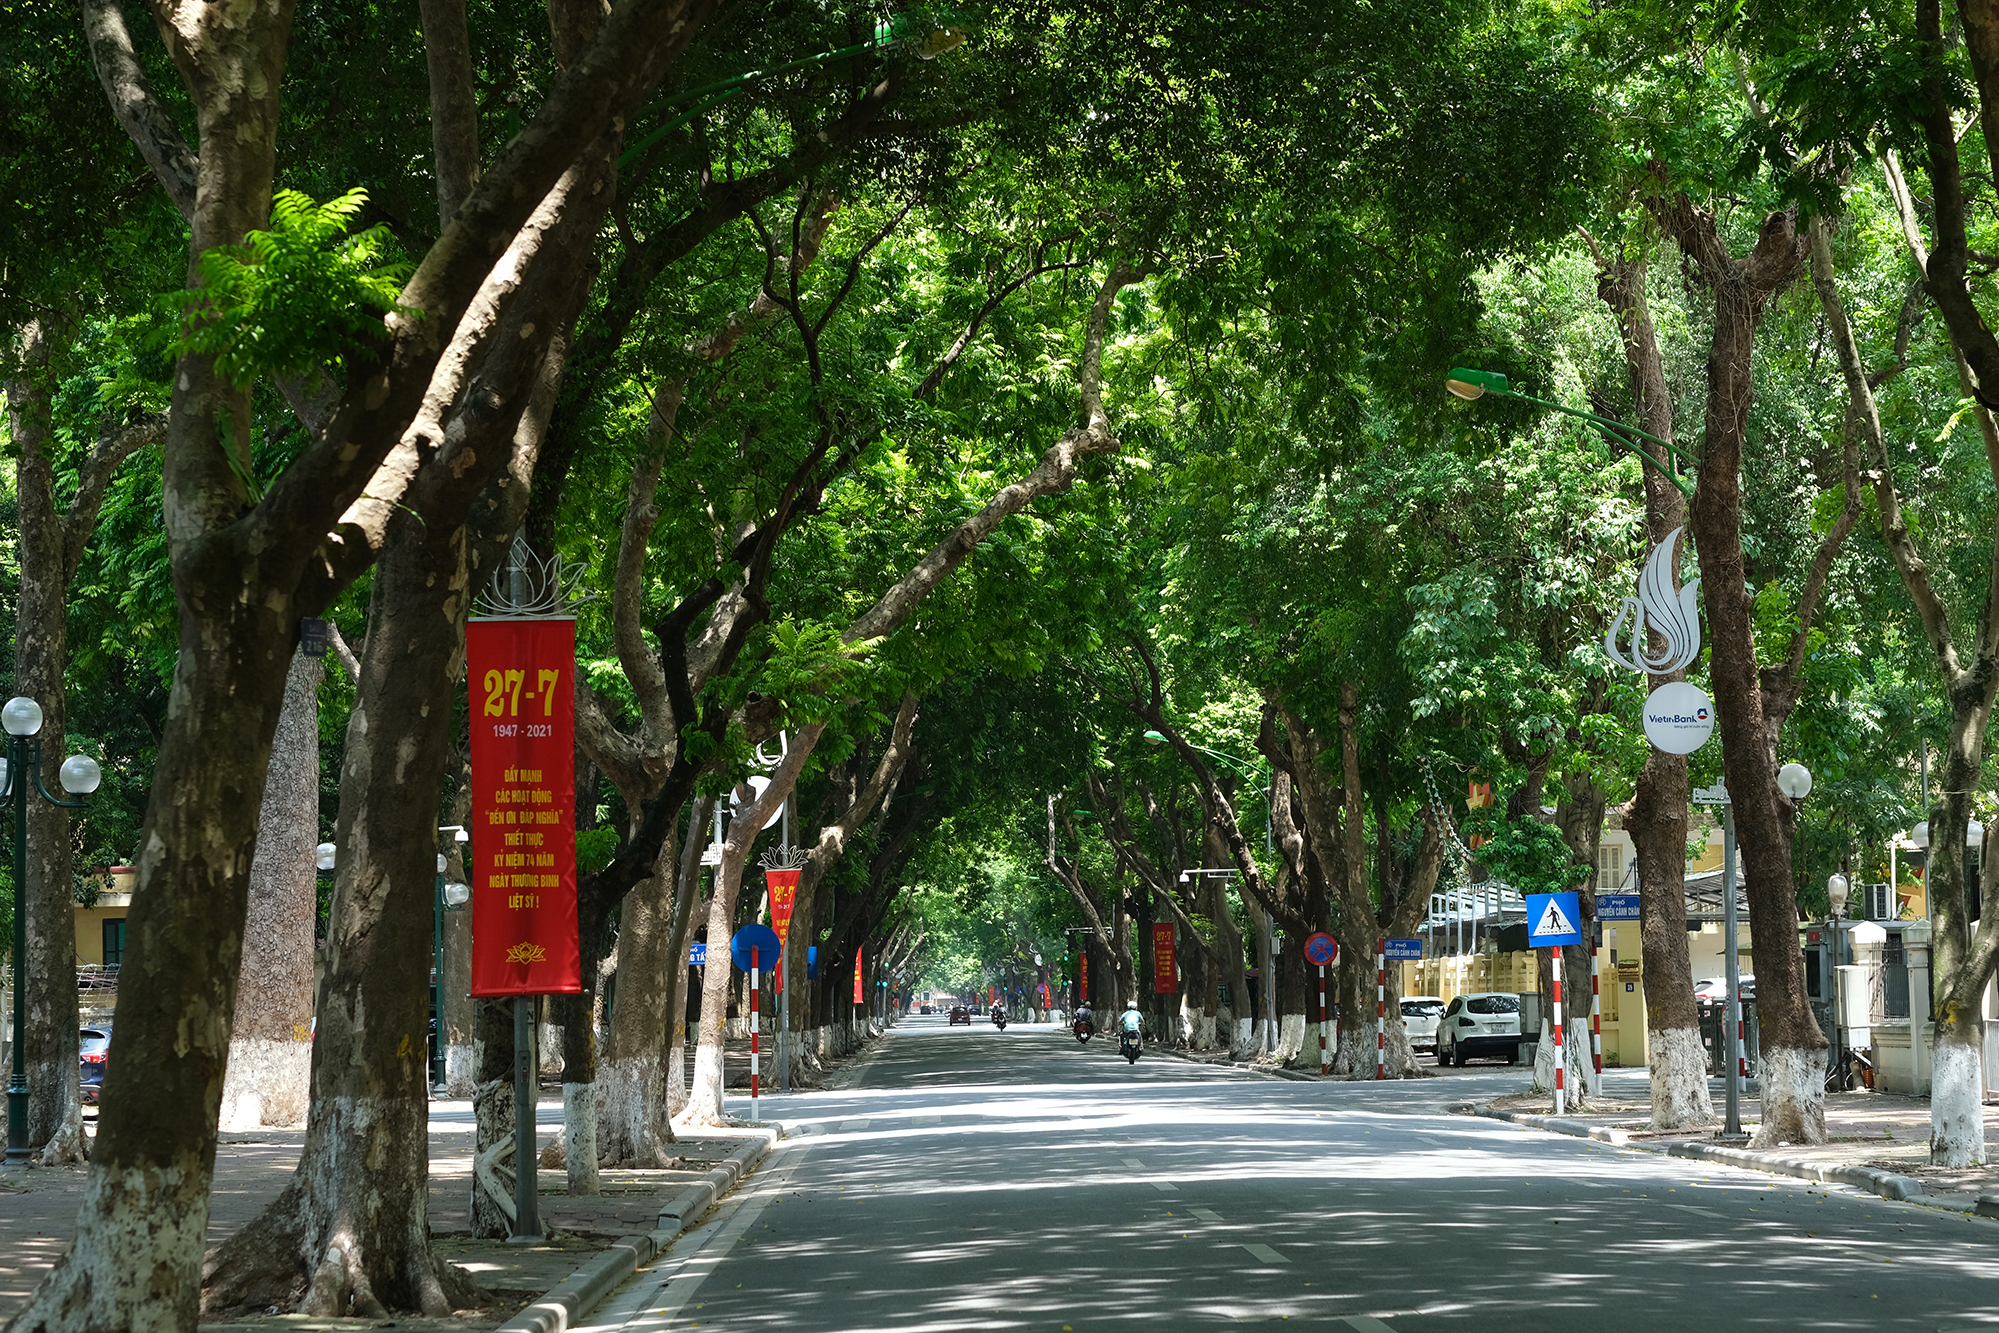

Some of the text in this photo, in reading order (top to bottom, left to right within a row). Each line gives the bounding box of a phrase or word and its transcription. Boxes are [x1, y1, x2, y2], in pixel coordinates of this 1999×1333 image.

[306, 640, 323, 652] 216
[484, 669, 559, 717] 27-7
[1648, 714, 1697, 723] VietinBank
[493, 724, 518, 737] 1947
[527, 724, 552, 737] 2021
[520, 769, 542, 785] MẠNH
[495, 788, 552, 806] CÁC HOẠT ĐỘNG
[506, 810, 516, 824] ƠN
[520, 809, 534, 824] ĐÁP
[504, 828, 543, 848] THIẾT THỰC
[494, 849, 554, 869] KỶ NIỆM 74 NĂM
[489, 872, 559, 888] NGÀY THƯƠNG BINH
[508, 892, 523, 911] LIỆT
[696, 951, 706, 961] TẤ
